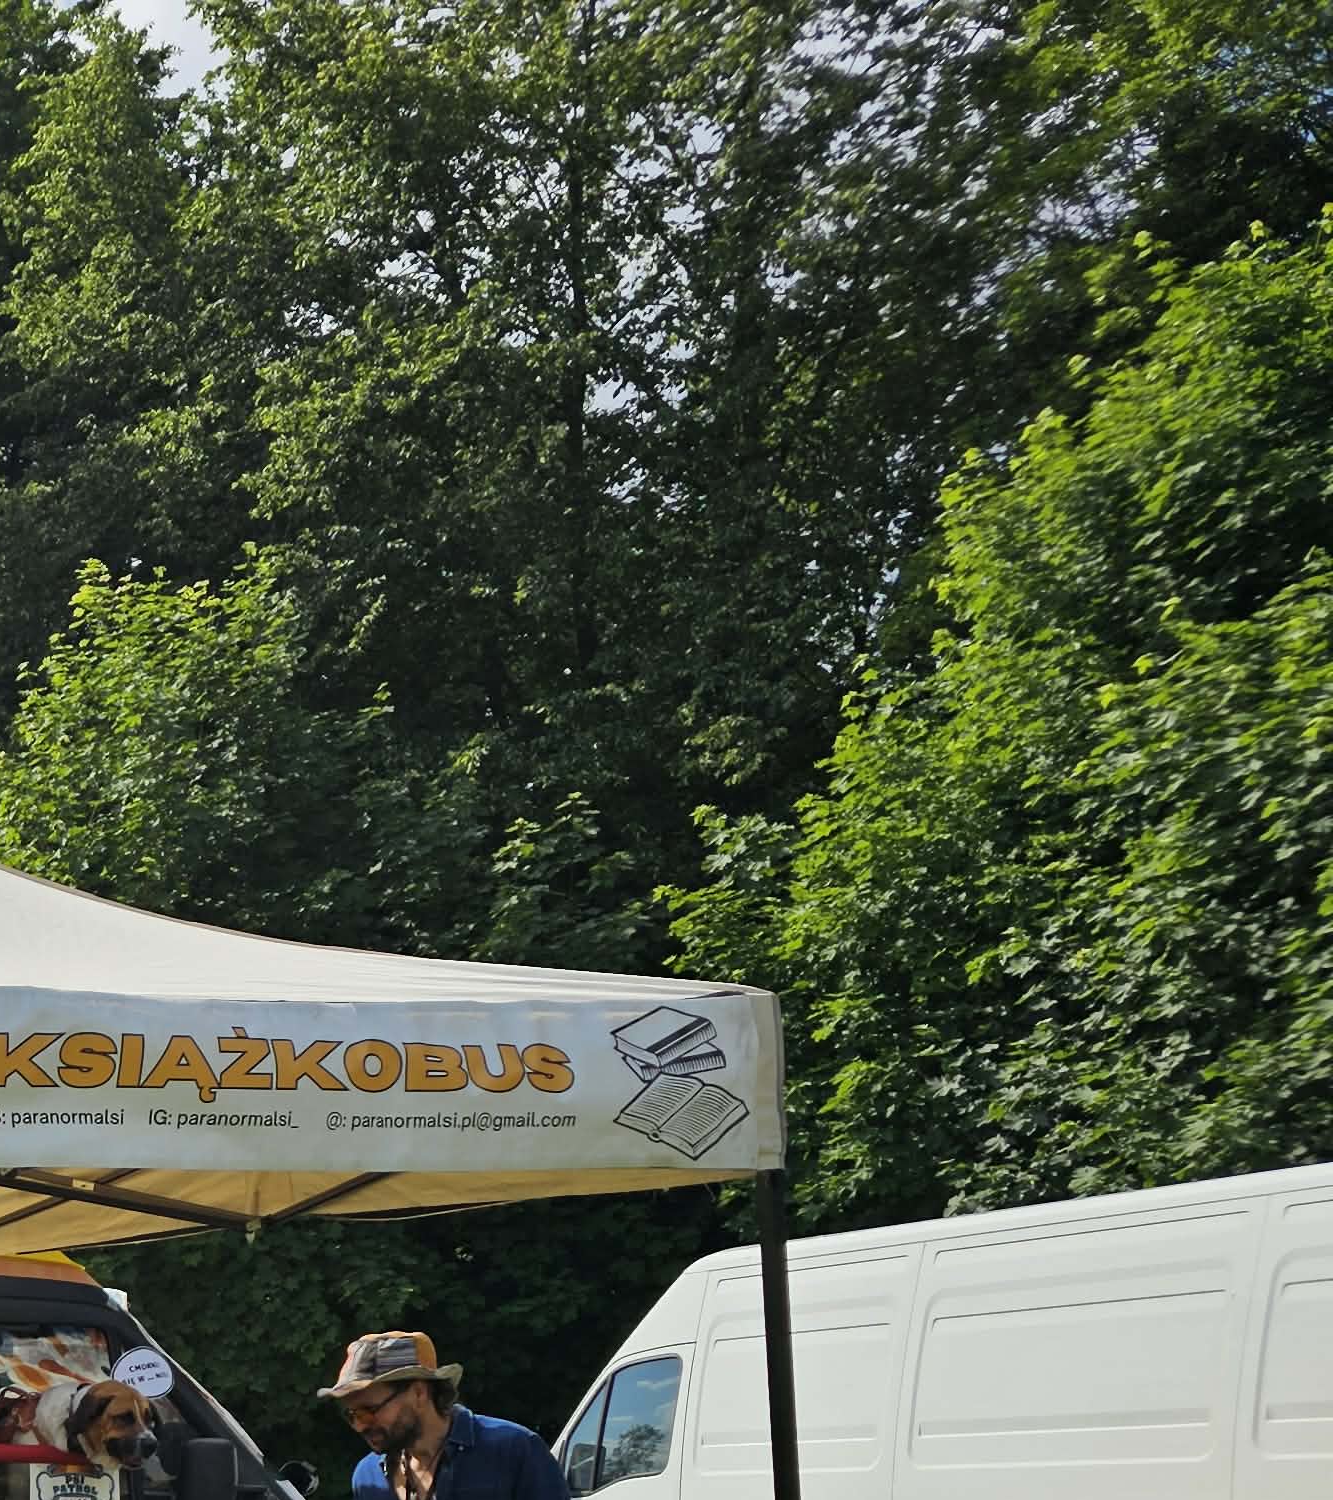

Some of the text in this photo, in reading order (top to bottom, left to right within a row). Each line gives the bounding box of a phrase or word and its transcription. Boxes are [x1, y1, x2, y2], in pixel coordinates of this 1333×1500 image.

[11, 1108, 124, 1128] paranormalsi
[148, 1110, 172, 1126] IG:
[177, 1110, 299, 1129] paranormalsi_
[326, 1112, 347, 1130] @:
[351, 1111, 577, 1131] paranormalsi.pl@gmail.com
[52, 1483, 99, 1496] PATROL
